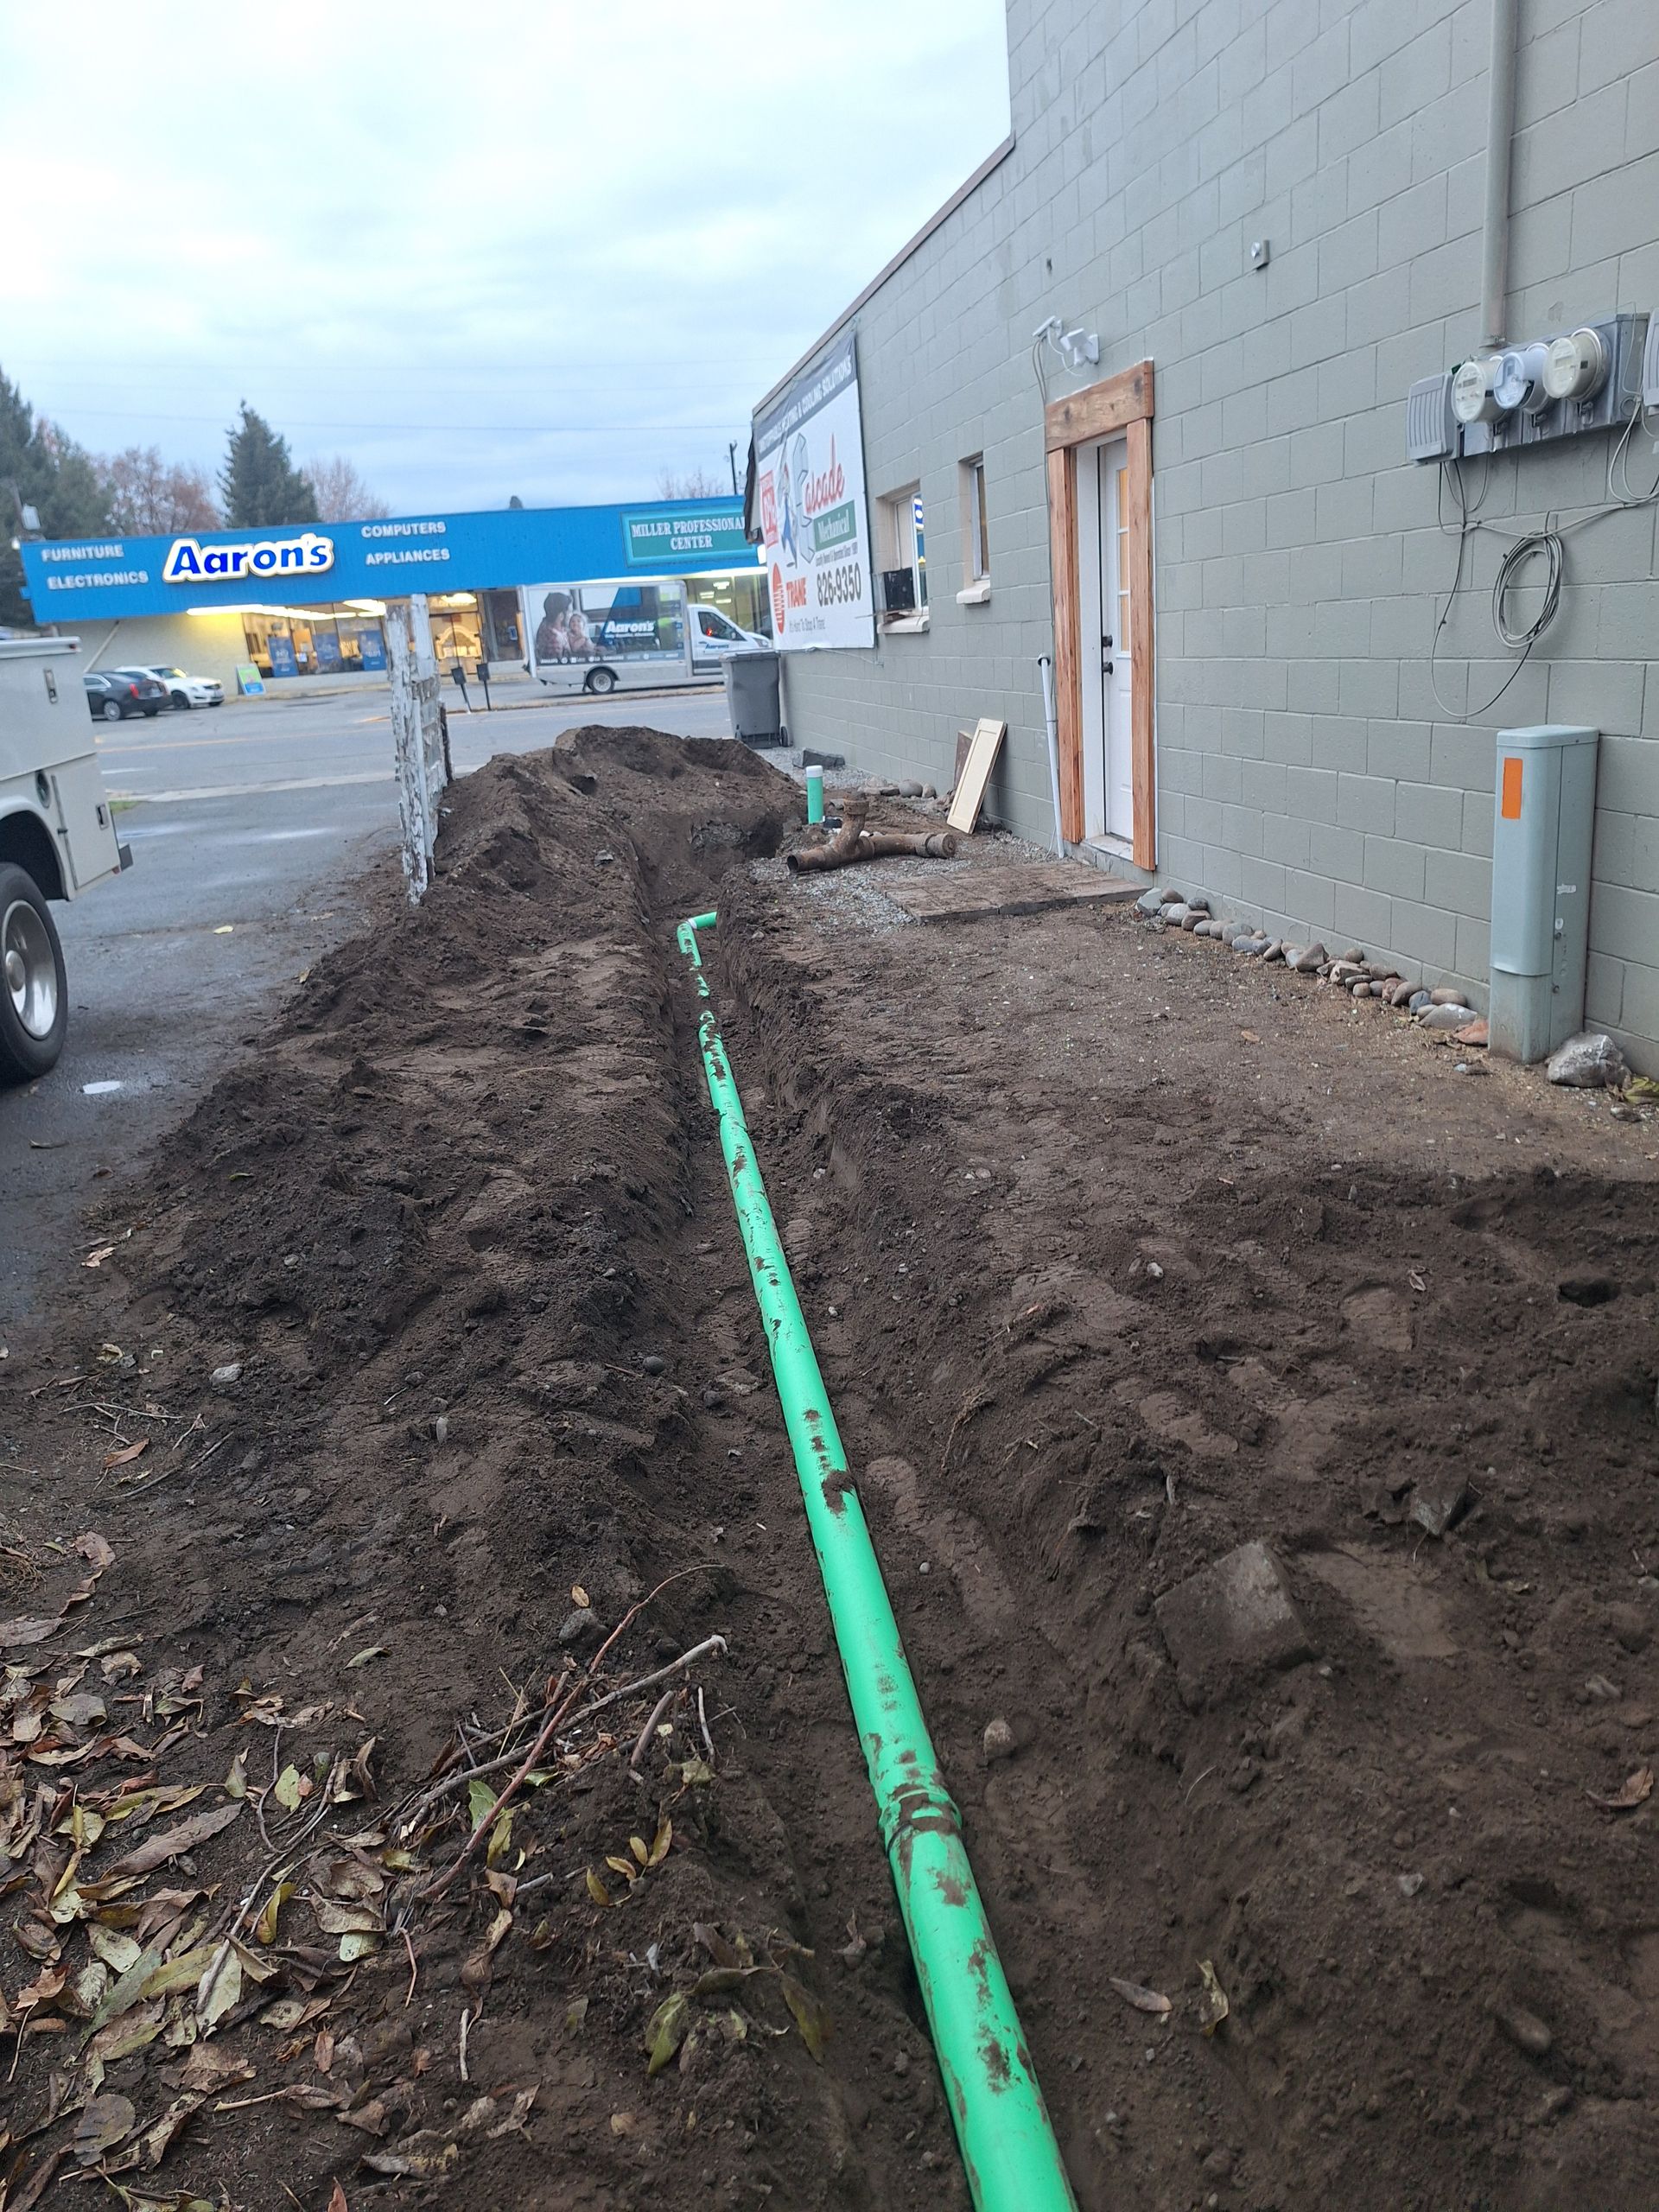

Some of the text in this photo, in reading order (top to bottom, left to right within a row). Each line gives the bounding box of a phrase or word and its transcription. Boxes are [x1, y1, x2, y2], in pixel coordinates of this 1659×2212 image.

[361, 521, 447, 538] COMPUTERS
[631, 522, 671, 537] MILLER
[817, 509, 850, 543] Mechanical
[670, 535, 713, 550] CENTER
[41, 544, 124, 563] FURNITURE
[167, 536, 331, 581] Aaron's
[365, 548, 450, 566] APPLIANCES
[47, 570, 149, 590] ELECTRONICS
[786, 577, 807, 609] TRANE
[605, 620, 656, 633] Aaron's
